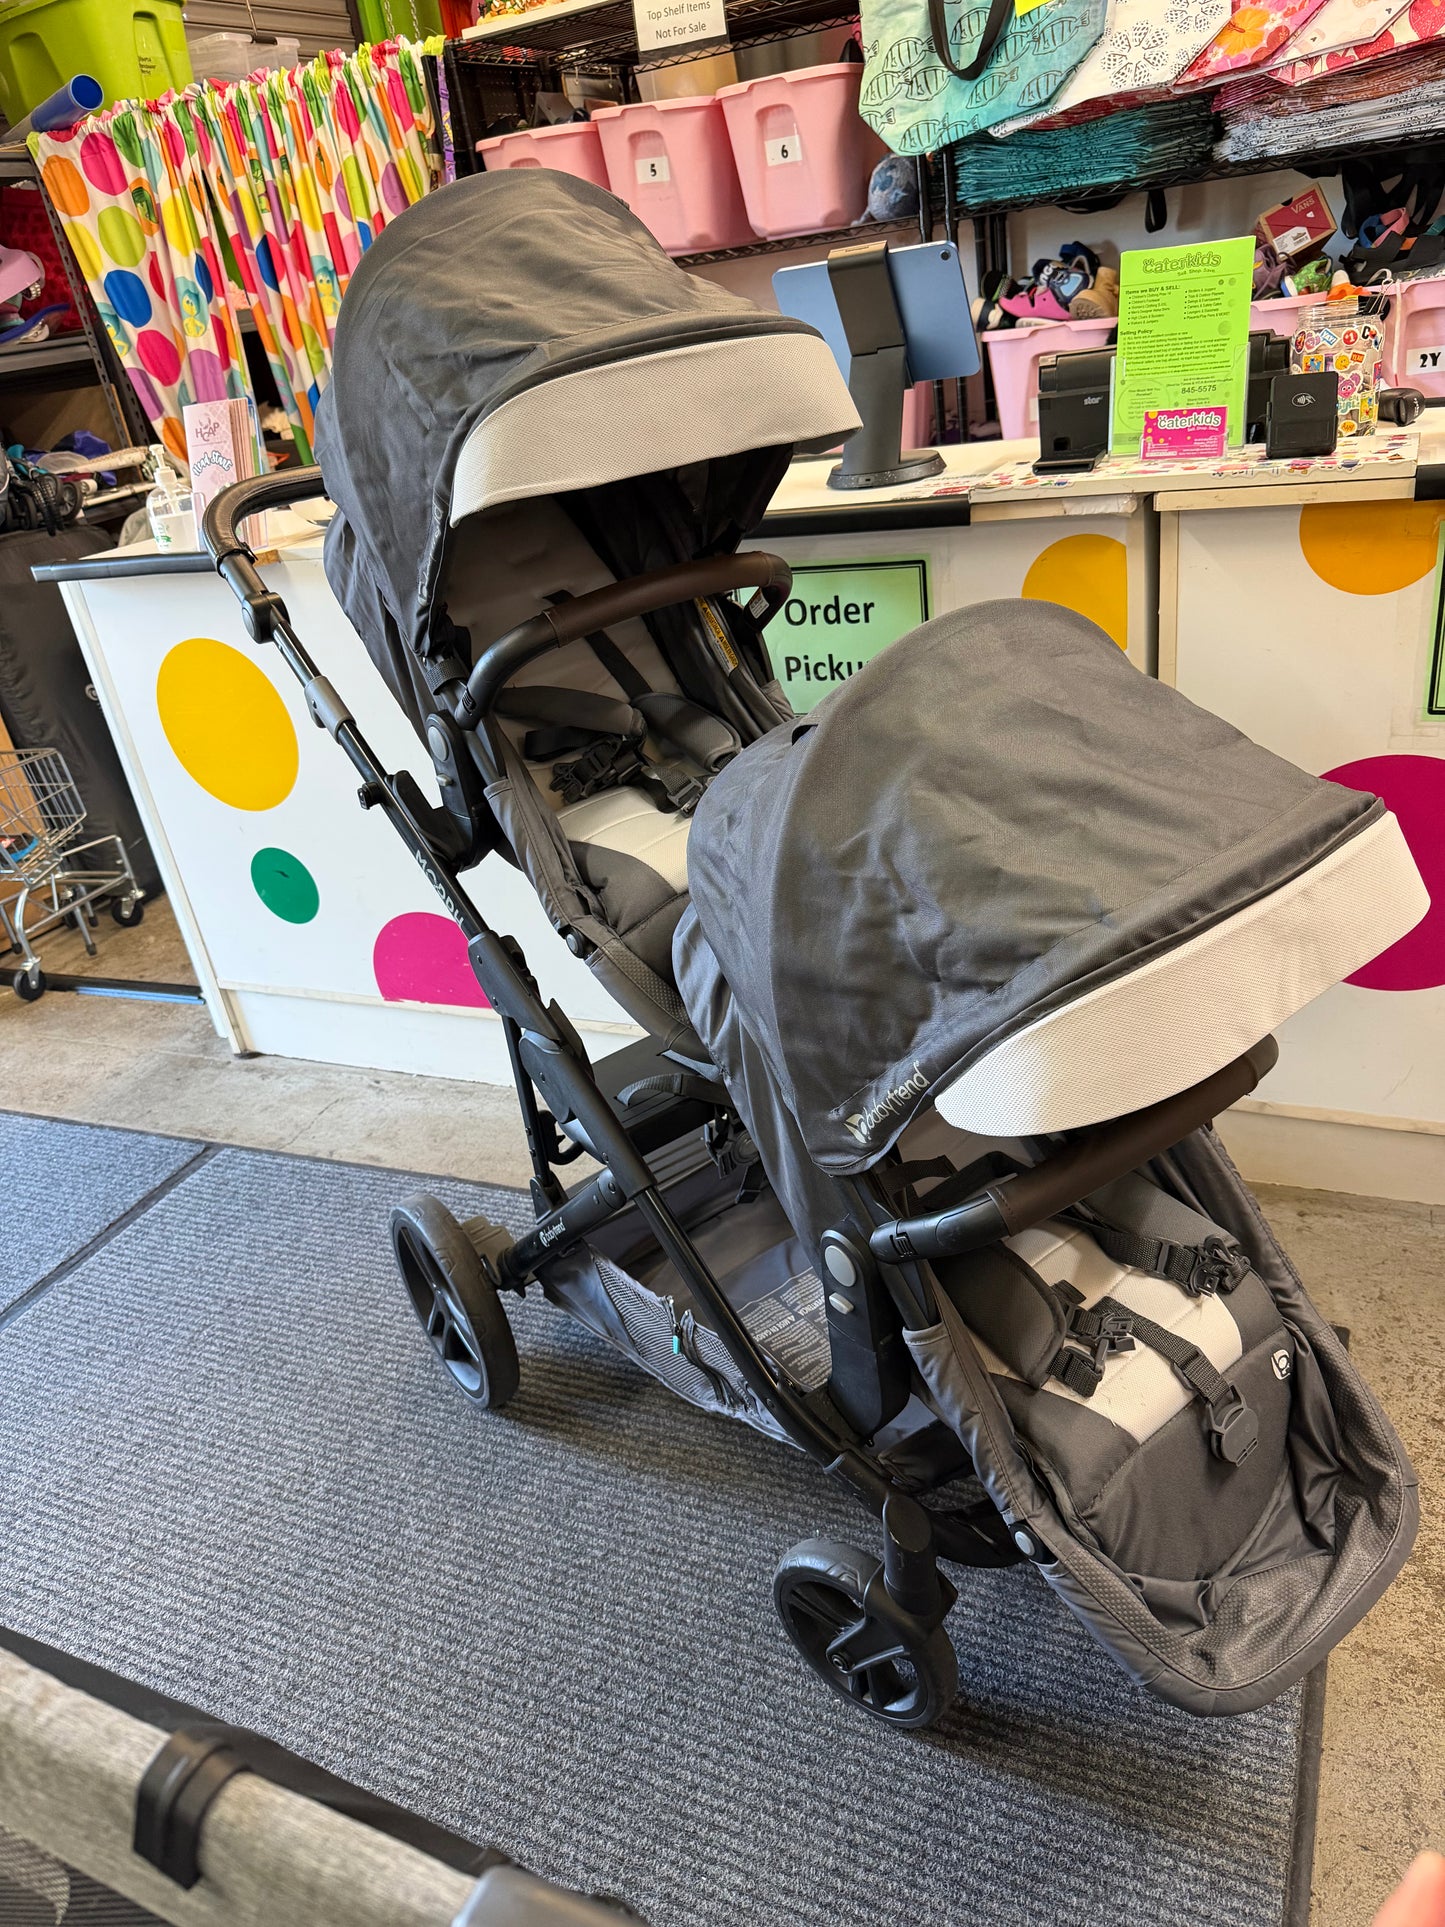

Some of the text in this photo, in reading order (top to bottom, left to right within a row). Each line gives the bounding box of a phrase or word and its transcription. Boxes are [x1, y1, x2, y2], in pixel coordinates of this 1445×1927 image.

[647, 1, 711, 21] Top Shelf Items
[655, 21, 707, 40] Not For Sale
[781, 144, 789, 159] 6
[649, 163, 657, 177] 5
[1290, 195, 1316, 215] VANS
[1419, 352, 1442, 368] 2Y
[1181, 384, 1217, 395] 845-5575
[1083, 396, 1103, 406] star
[784, 595, 875, 626] Order
[784, 653, 866, 682] Picku
[862, 1062, 930, 1132] babytrend
